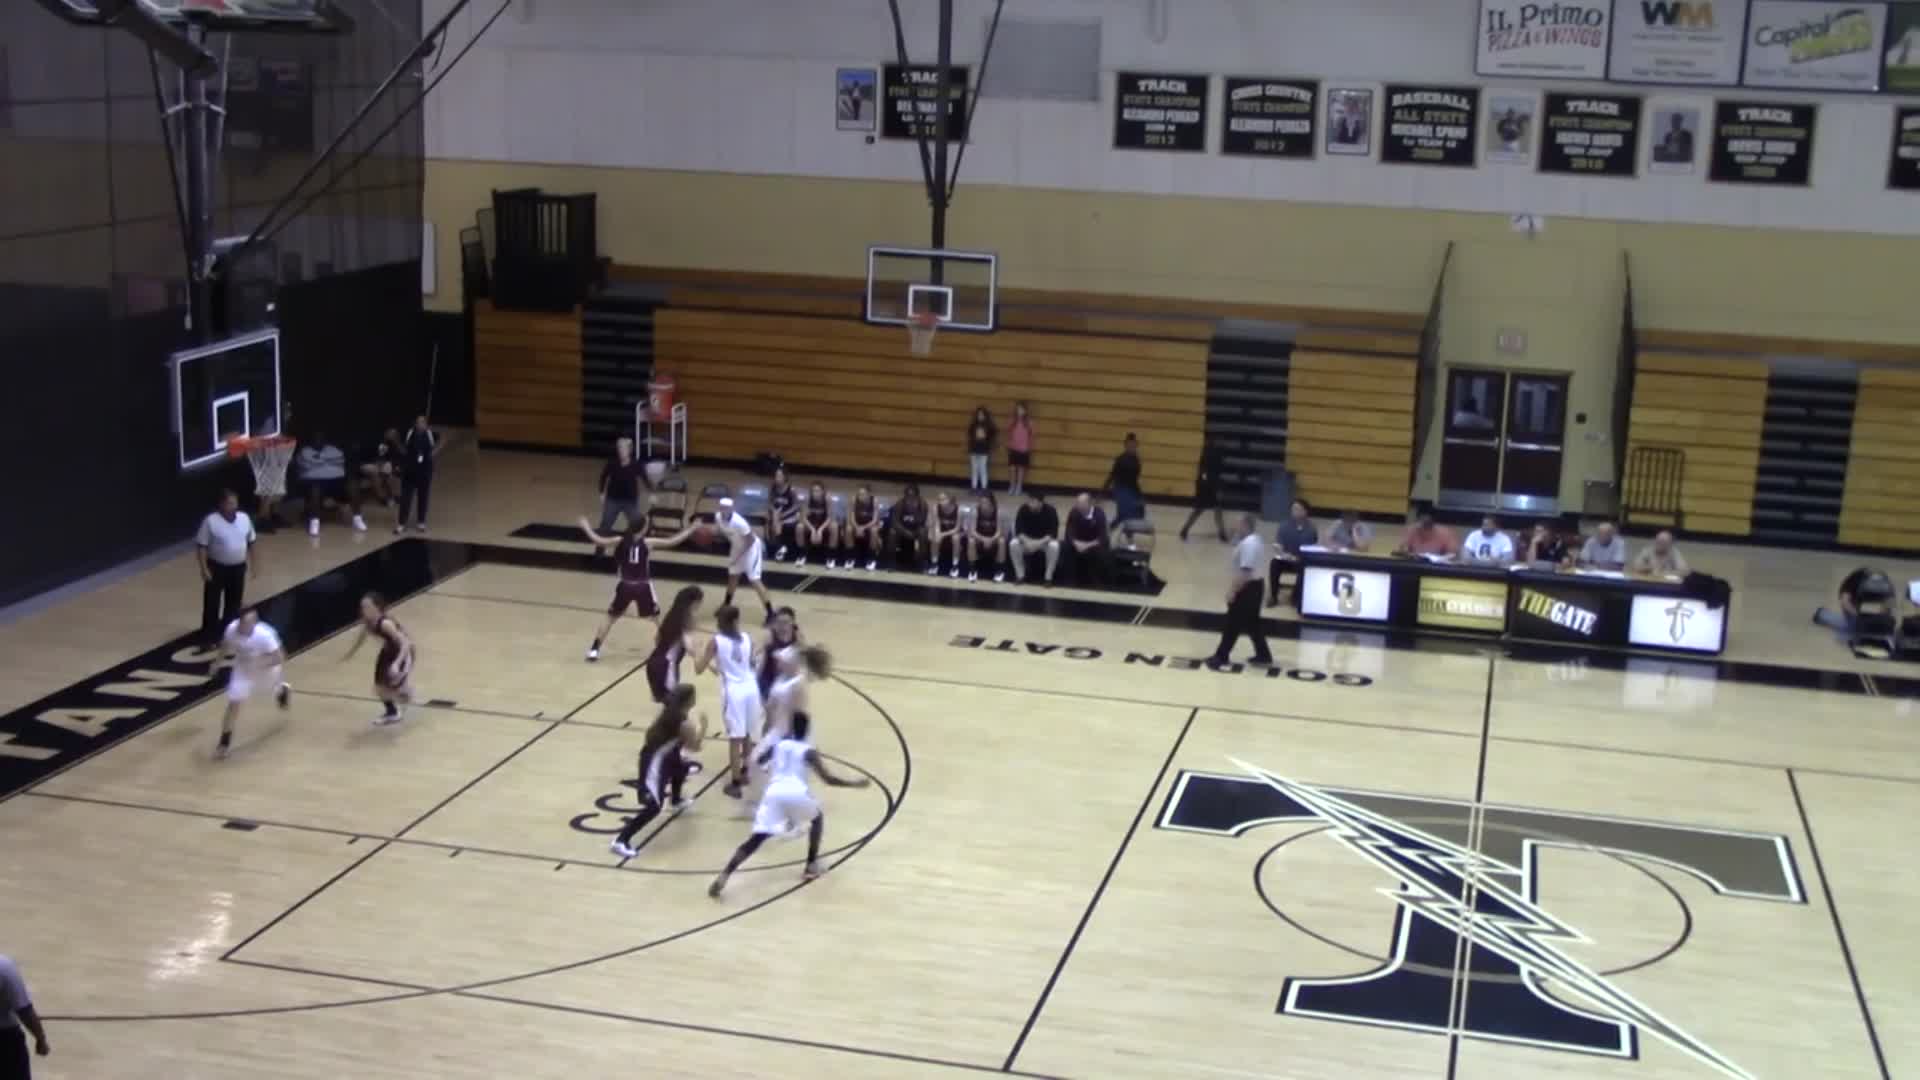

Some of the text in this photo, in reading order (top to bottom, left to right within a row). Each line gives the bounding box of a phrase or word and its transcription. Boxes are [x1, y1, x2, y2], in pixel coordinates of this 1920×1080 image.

[1519, 4, 1604, 29] Primo
[1641, 1, 1713, 26] WM
[1487, 30, 1532, 52] PIZZA
[1545, 26, 1601, 48] WINGS
[1137, 79, 1187, 94] TRACK
[1392, 92, 1470, 110] BASEBALL
[1565, 100, 1619, 116] TRACK
[1393, 110, 1468, 124] ALL STATE
[1737, 107, 1792, 123] TRACK
[948, 633, 1374, 688] GOLDEN GATE
